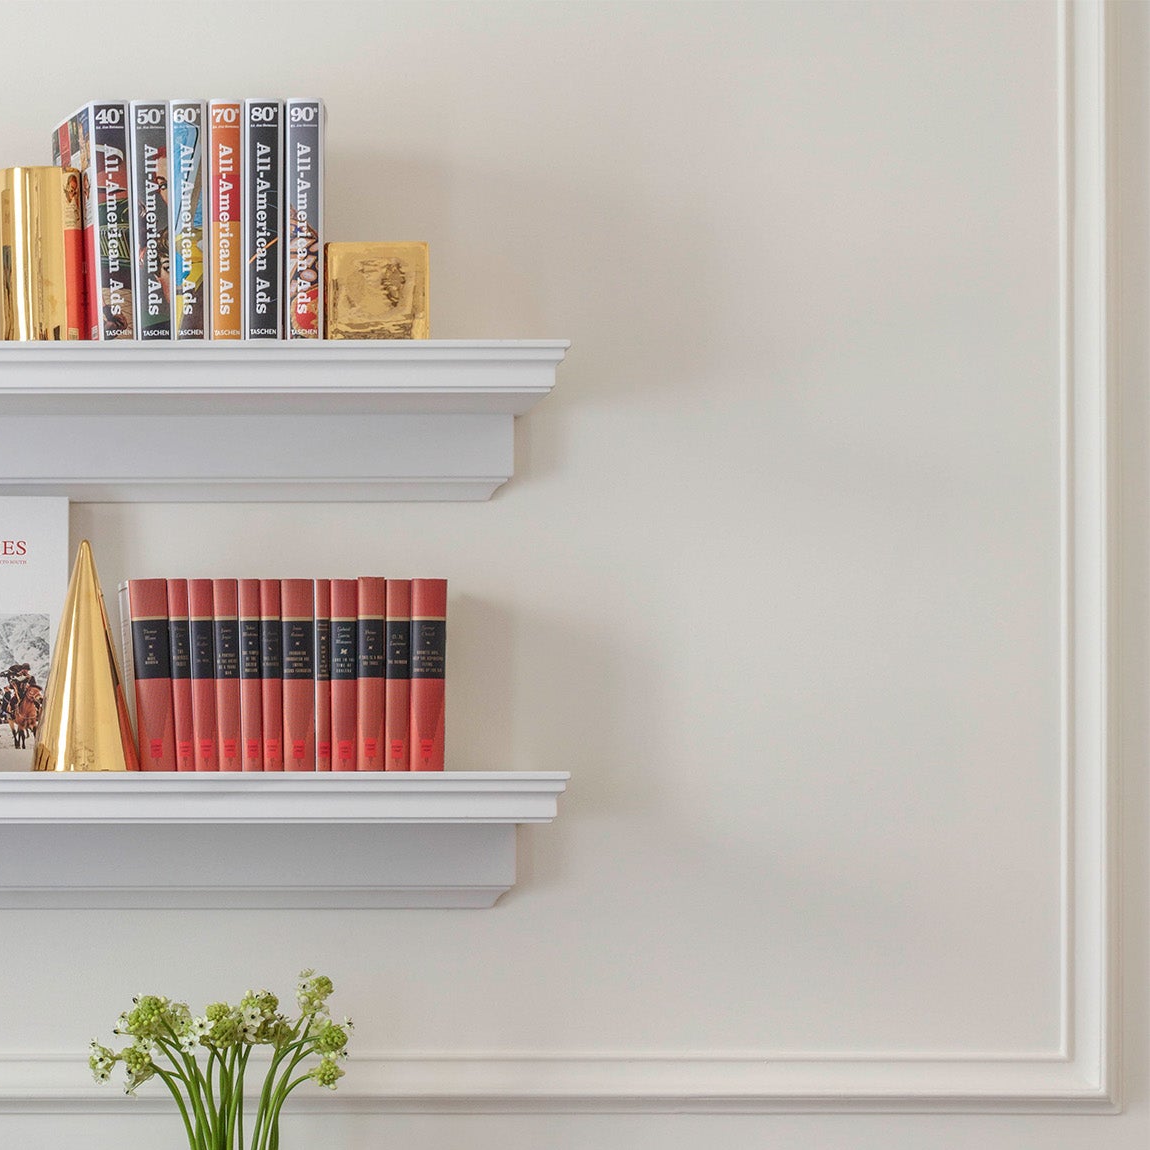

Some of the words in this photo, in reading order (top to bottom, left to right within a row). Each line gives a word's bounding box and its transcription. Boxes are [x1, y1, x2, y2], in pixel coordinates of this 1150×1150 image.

[104, 144, 121, 273] All-American
[144, 144, 160, 273] All-American
[180, 144, 196, 272] All-American
[219, 144, 235, 272] All-American
[256, 142, 271, 272] All-American
[297, 143, 312, 272] All-American
[109, 278, 125, 315] Ads
[147, 279, 163, 315] Ads
[182, 278, 197, 315] Ads
[219, 278, 235, 315] Ads
[256, 277, 271, 314] Ads
[297, 278, 311, 314] Ads
